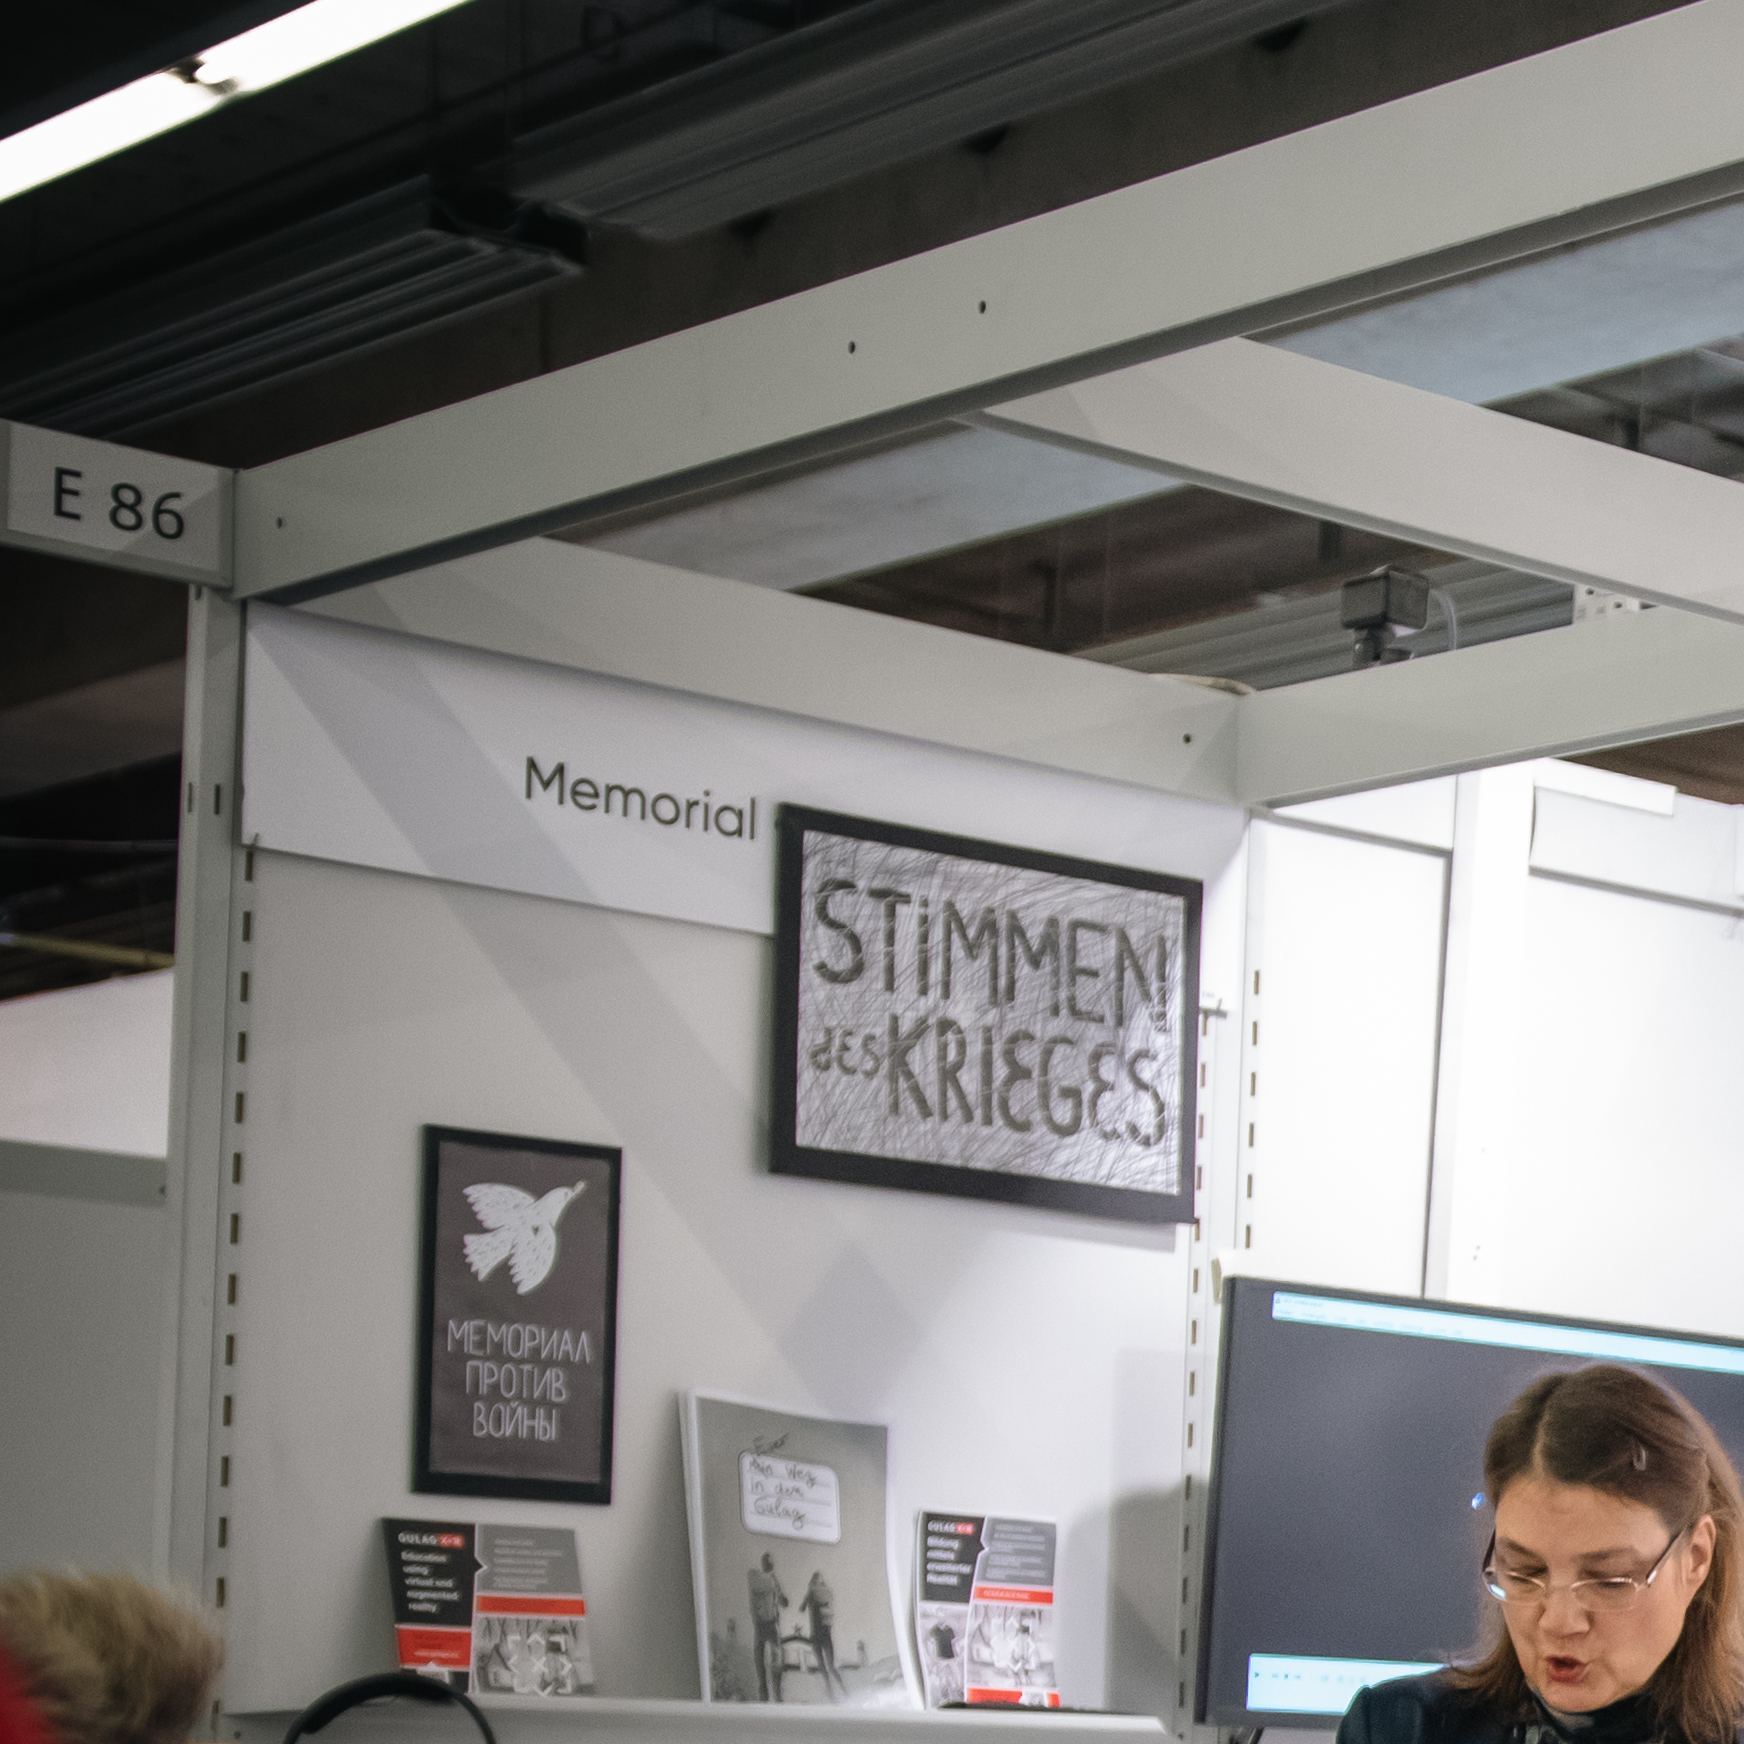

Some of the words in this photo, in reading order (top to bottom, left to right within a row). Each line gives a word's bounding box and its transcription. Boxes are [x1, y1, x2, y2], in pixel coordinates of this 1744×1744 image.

[53, 467, 82, 520] E
[108, 482, 185, 540] 86
[525, 756, 757, 841] Memorial
[447, 1318, 591, 1364] МЕМОРИАЛ
[466, 1360, 567, 1402] ПРОТИВ
[472, 1400, 557, 1441] ВОЙНЫ
